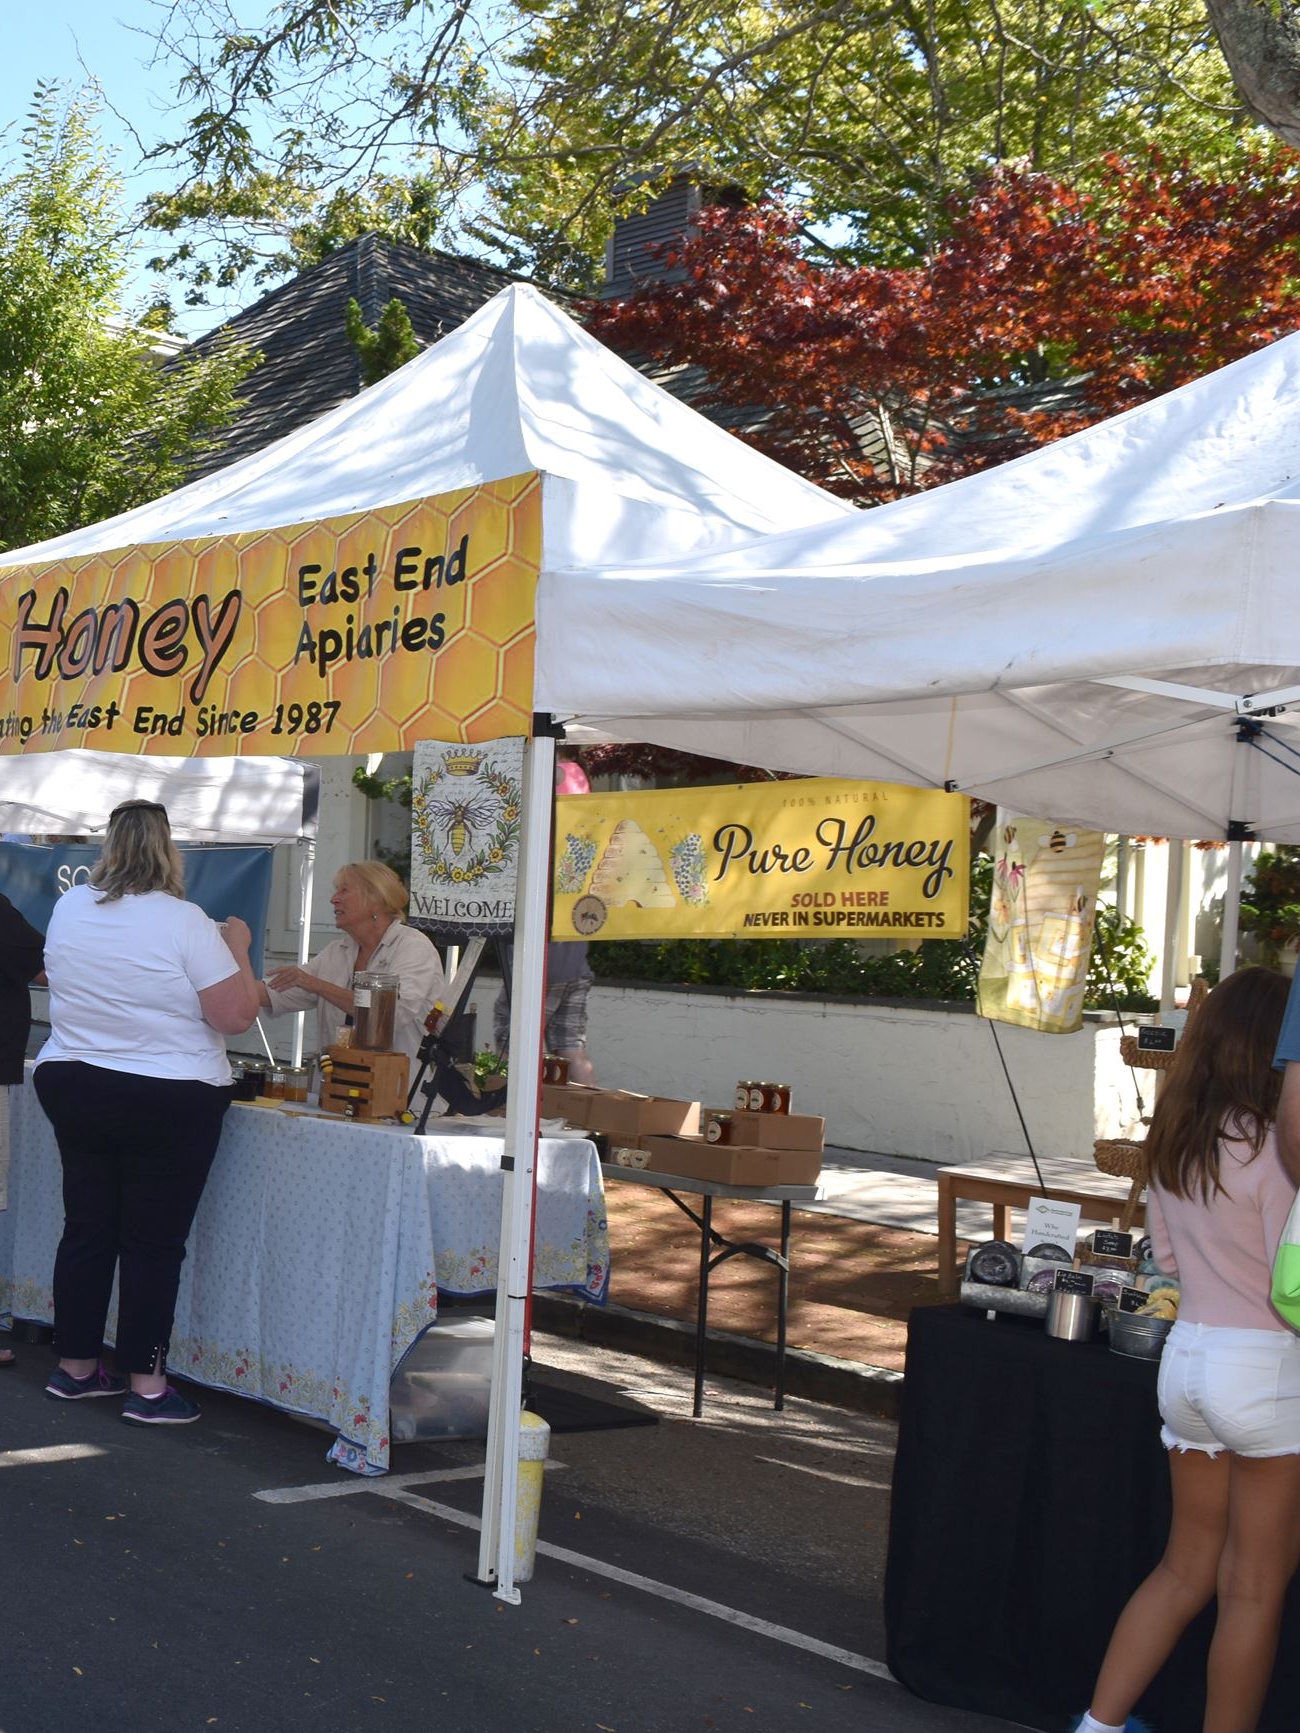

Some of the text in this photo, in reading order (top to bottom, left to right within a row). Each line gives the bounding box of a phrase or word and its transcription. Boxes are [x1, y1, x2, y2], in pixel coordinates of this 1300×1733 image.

[299, 534, 469, 607] East End
[13, 586, 242, 705] Honey
[294, 605, 446, 678] Apiaries
[41, 707, 63, 735] the
[66, 700, 120, 730] East
[133, 705, 186, 736] End
[196, 704, 259, 737] Since
[271, 700, 341, 735] 1987
[783, 791, 888, 808] 100% NATURAL
[713, 814, 954, 899] Pure Honey
[411, 891, 513, 919] WELCOME
[791, 890, 889, 908] SOLD HERE
[743, 911, 945, 928] NEVER IN SUPERMARKETS
